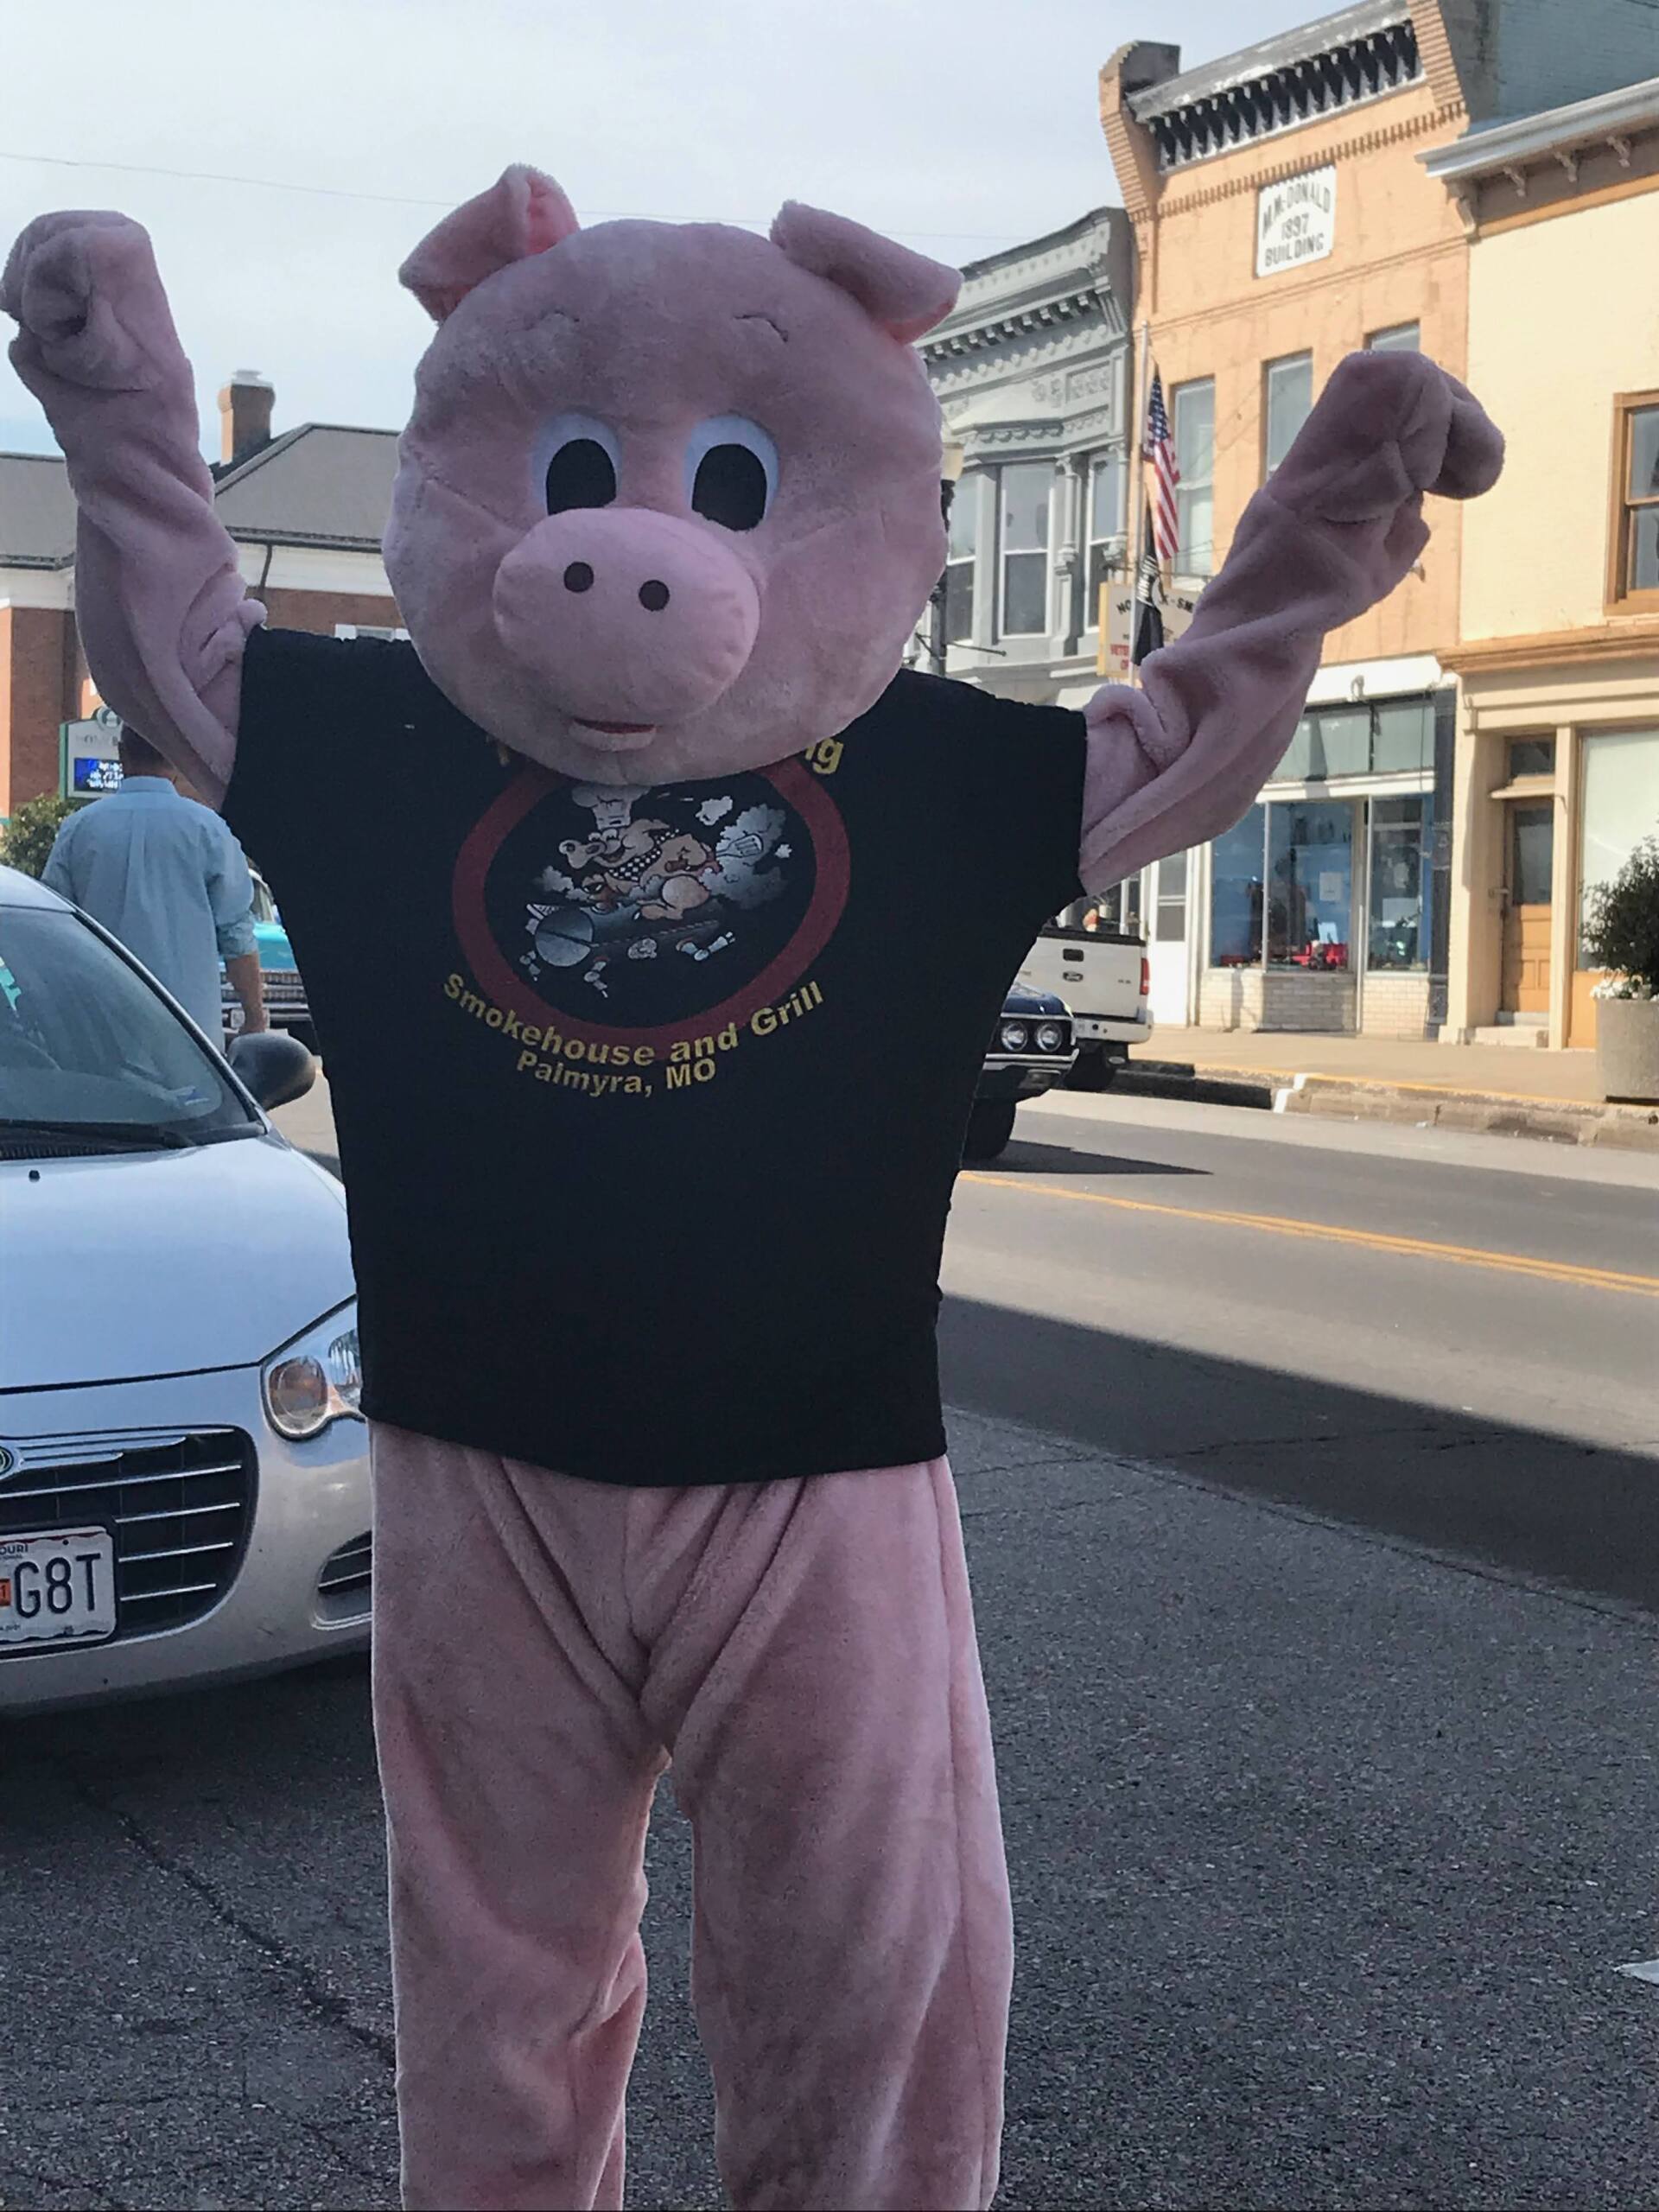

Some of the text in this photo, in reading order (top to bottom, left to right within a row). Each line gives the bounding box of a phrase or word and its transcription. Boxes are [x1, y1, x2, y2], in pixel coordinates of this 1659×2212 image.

[1264, 232, 1325, 267] BUILDING
[443, 973, 823, 1065] Smokehouse and Grill
[517, 1050, 715, 1097] Palmyra, MO
[14, 1553, 102, 1618] G8T
